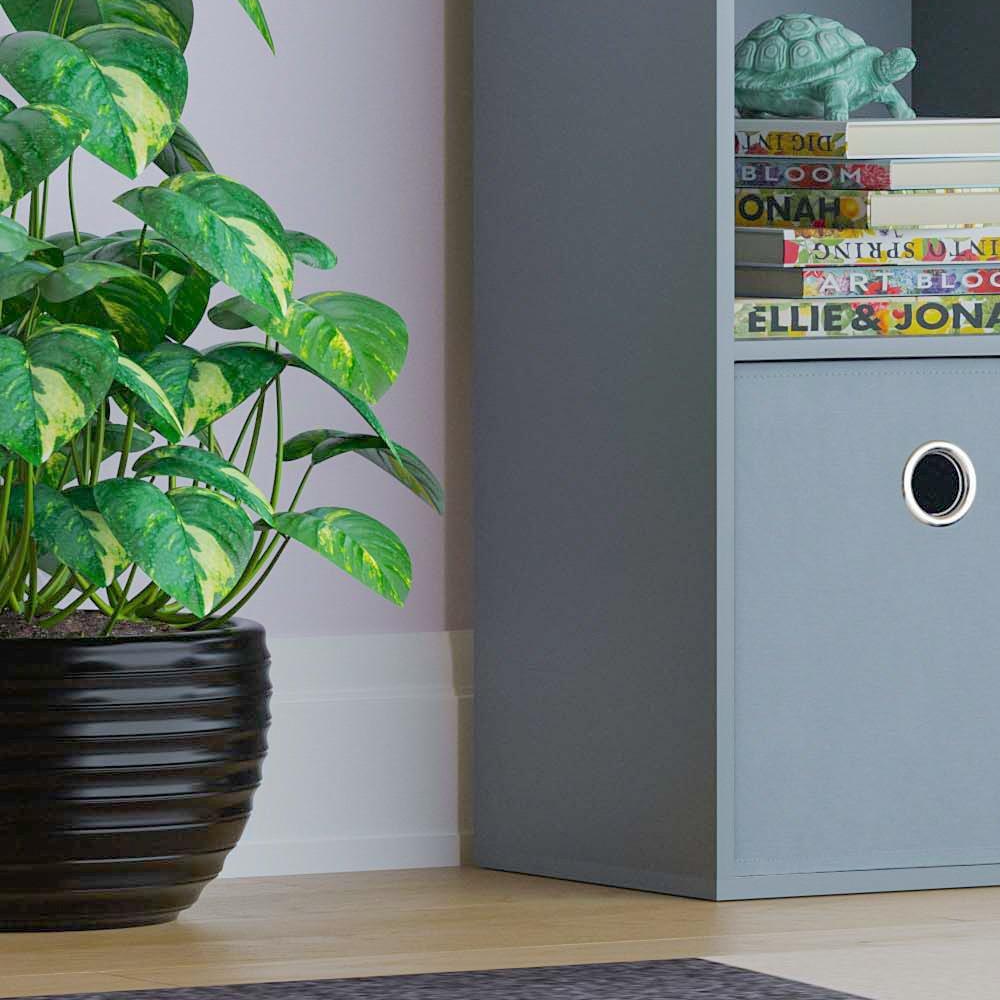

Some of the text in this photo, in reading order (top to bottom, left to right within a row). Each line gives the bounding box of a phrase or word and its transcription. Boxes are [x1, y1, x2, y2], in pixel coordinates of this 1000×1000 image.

[735, 133, 833, 152] DIG INT
[742, 165, 862, 184] BLOOM
[814, 241, 915, 260] SPRING
[926, 239, 1000, 257] INTO
[819, 272, 894, 293] ART
[748, 304, 843, 333] ELLIE
[851, 303, 881, 332] &
